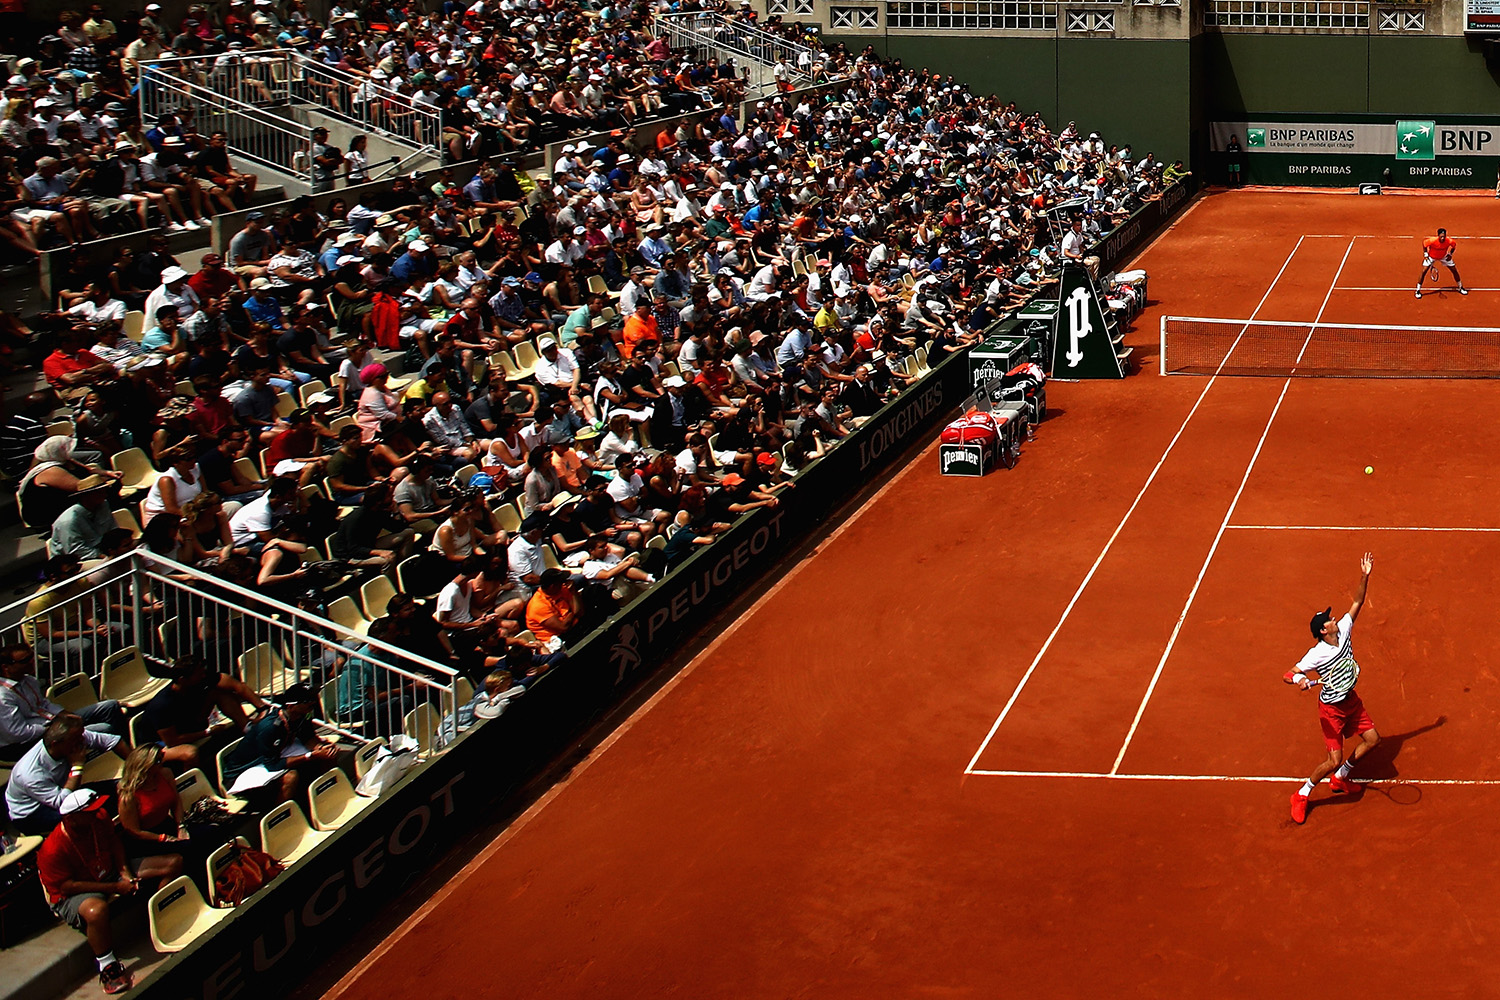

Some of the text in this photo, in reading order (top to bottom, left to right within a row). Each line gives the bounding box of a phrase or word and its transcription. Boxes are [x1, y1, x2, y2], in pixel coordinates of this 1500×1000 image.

[1270, 129, 1354, 142] BNP PARIBAS
[1441, 130, 1492, 151] BNP
[1288, 165, 1351, 175] BNP PARIBAS
[1409, 166, 1472, 176] BNP PARIBAS
[973, 366, 1005, 388] perrier
[858, 380, 943, 472] LONGINES
[647, 510, 786, 644] PEUGEOT
[184, 770, 466, 1000] EUGEOT
